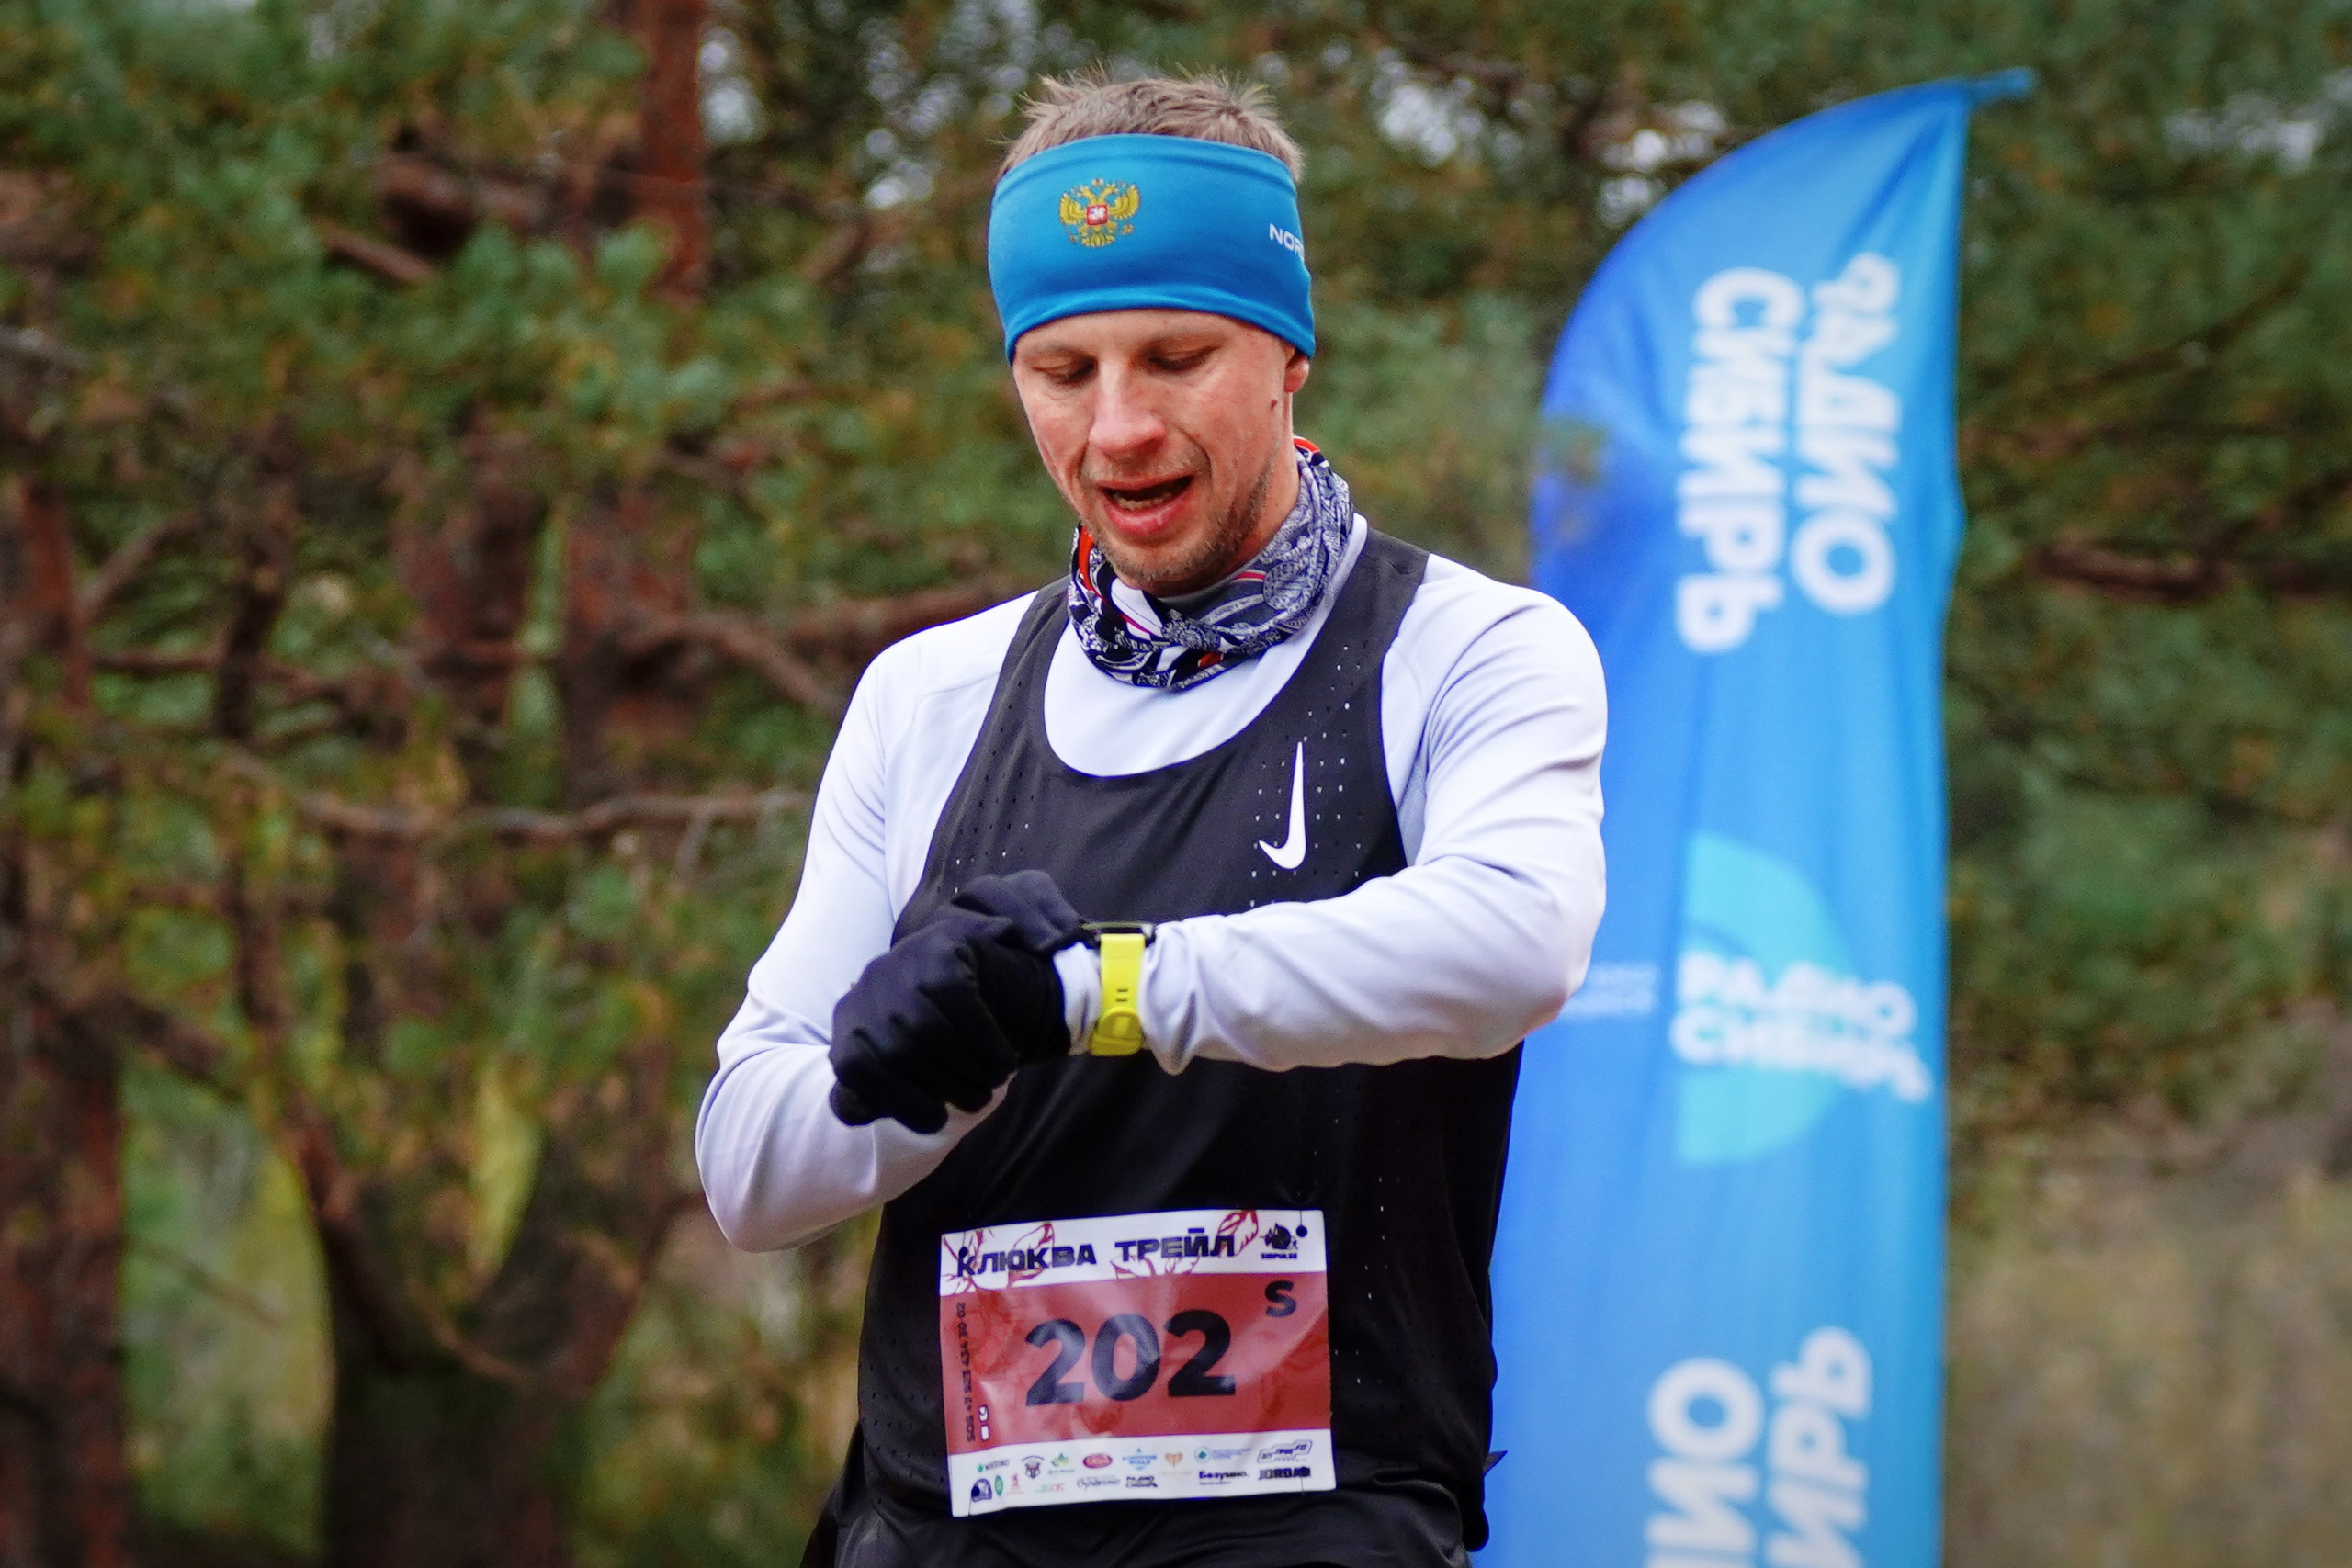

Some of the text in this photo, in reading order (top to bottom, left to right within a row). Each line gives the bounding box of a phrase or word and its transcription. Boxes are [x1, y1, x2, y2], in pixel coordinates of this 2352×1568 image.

[1678, 268, 1804, 650] СИБИРЬ
[1792, 252, 1900, 613] РАДИО
[957, 1227, 1235, 1277] КЛЮКВА ТРЕЙЛ
[1264, 1280, 1296, 1317] S
[1025, 1309, 1236, 1407] 202
[1645, 1356, 1764, 1568] ИО
